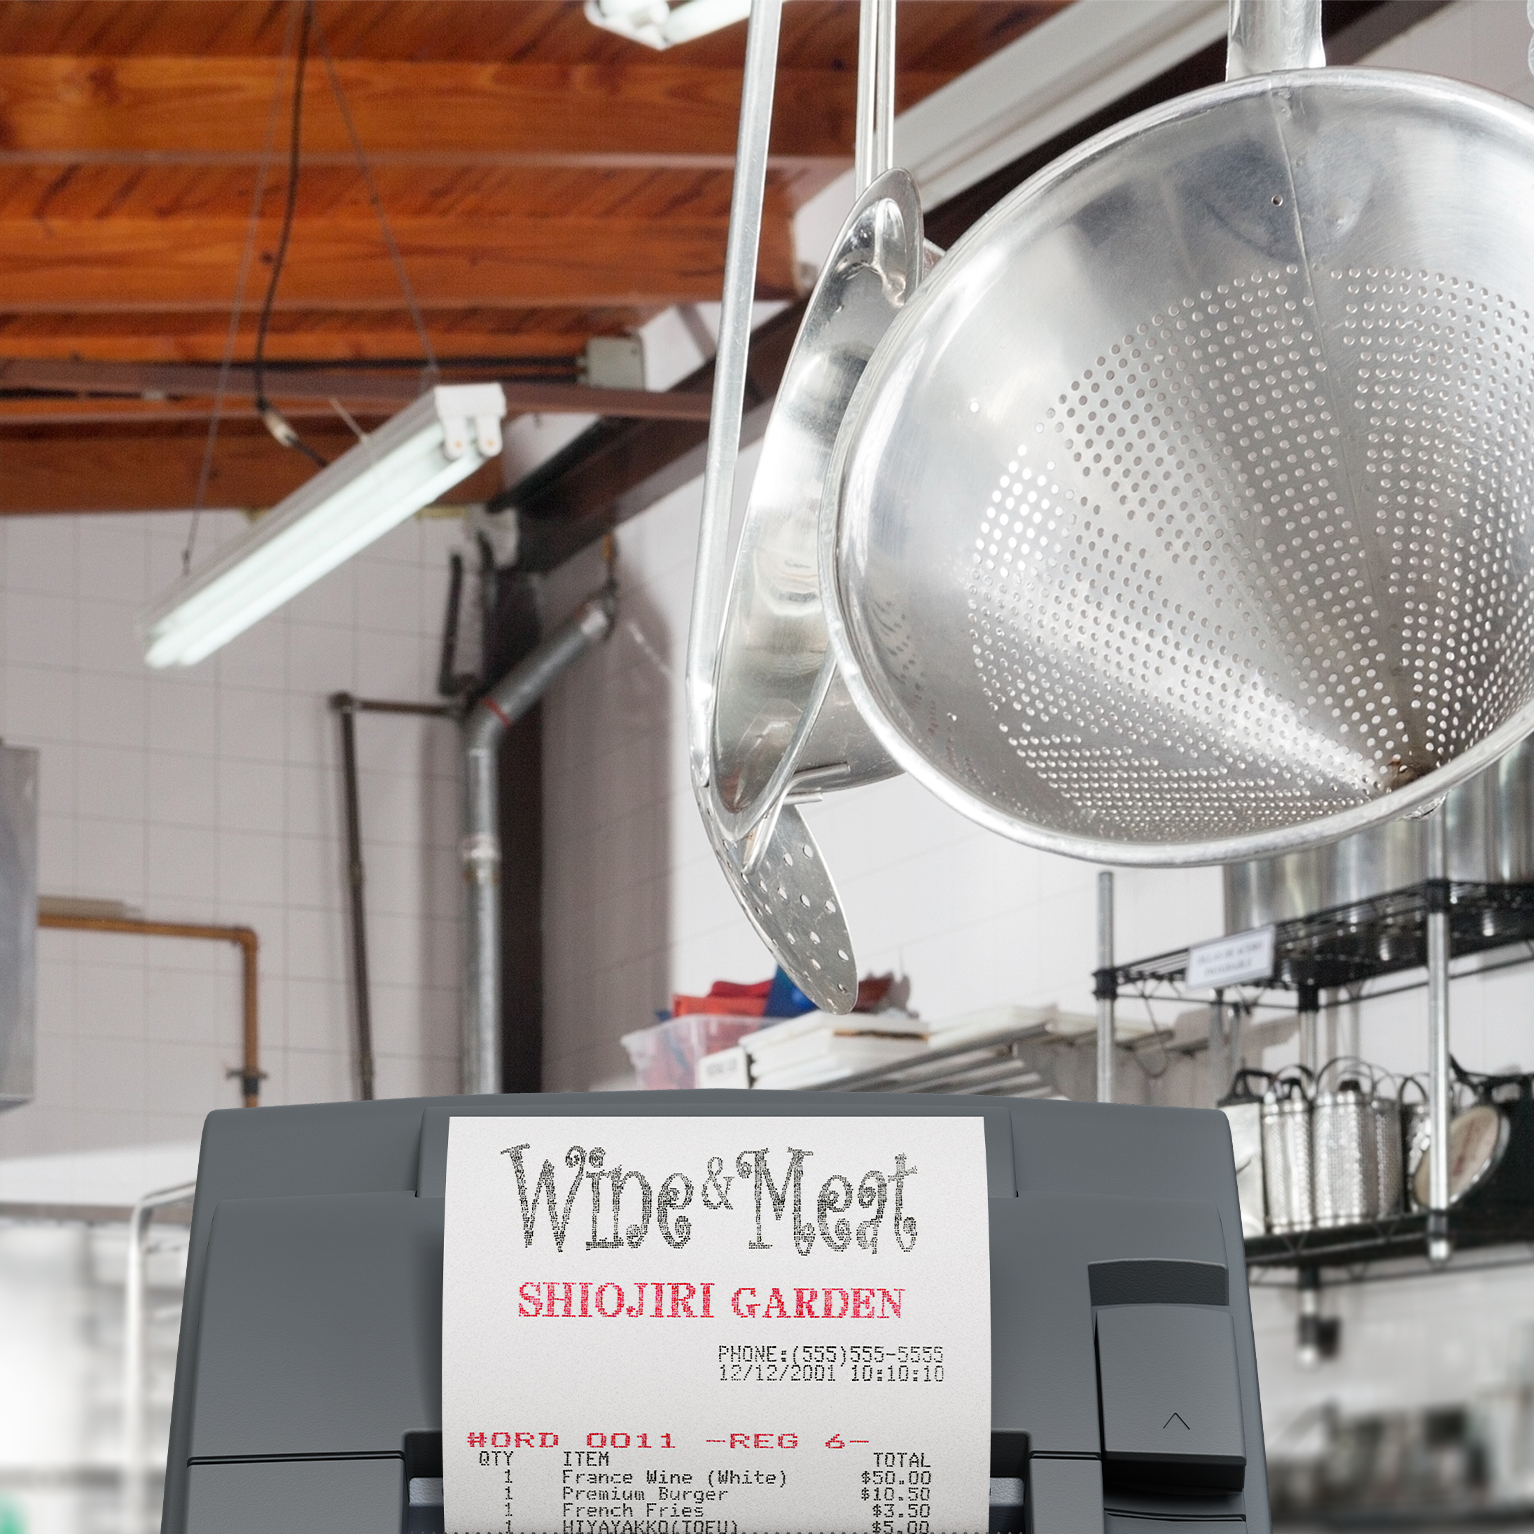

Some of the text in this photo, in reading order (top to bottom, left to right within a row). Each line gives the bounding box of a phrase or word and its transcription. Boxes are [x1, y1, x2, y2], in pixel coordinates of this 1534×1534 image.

[518, 1281, 906, 1319] SHIOJIRI GARDEN
[718, 1344, 944, 1367] PHONE:(555)555-5555
[719, 1365, 945, 1383] 12/12/2001 10:10:10
[466, 1431, 560, 1449] #ORD
[586, 1432, 676, 1449] 0011
[478, 1450, 932, 1468] QTY ITEM TOTAL
[504, 1468, 932, 1489] 1 France Wine (White) $50.00
[504, 1484, 931, 1505] 1 Premium Burger $10.50
[504, 1502, 931, 1519] 1 French Fries $3.50
